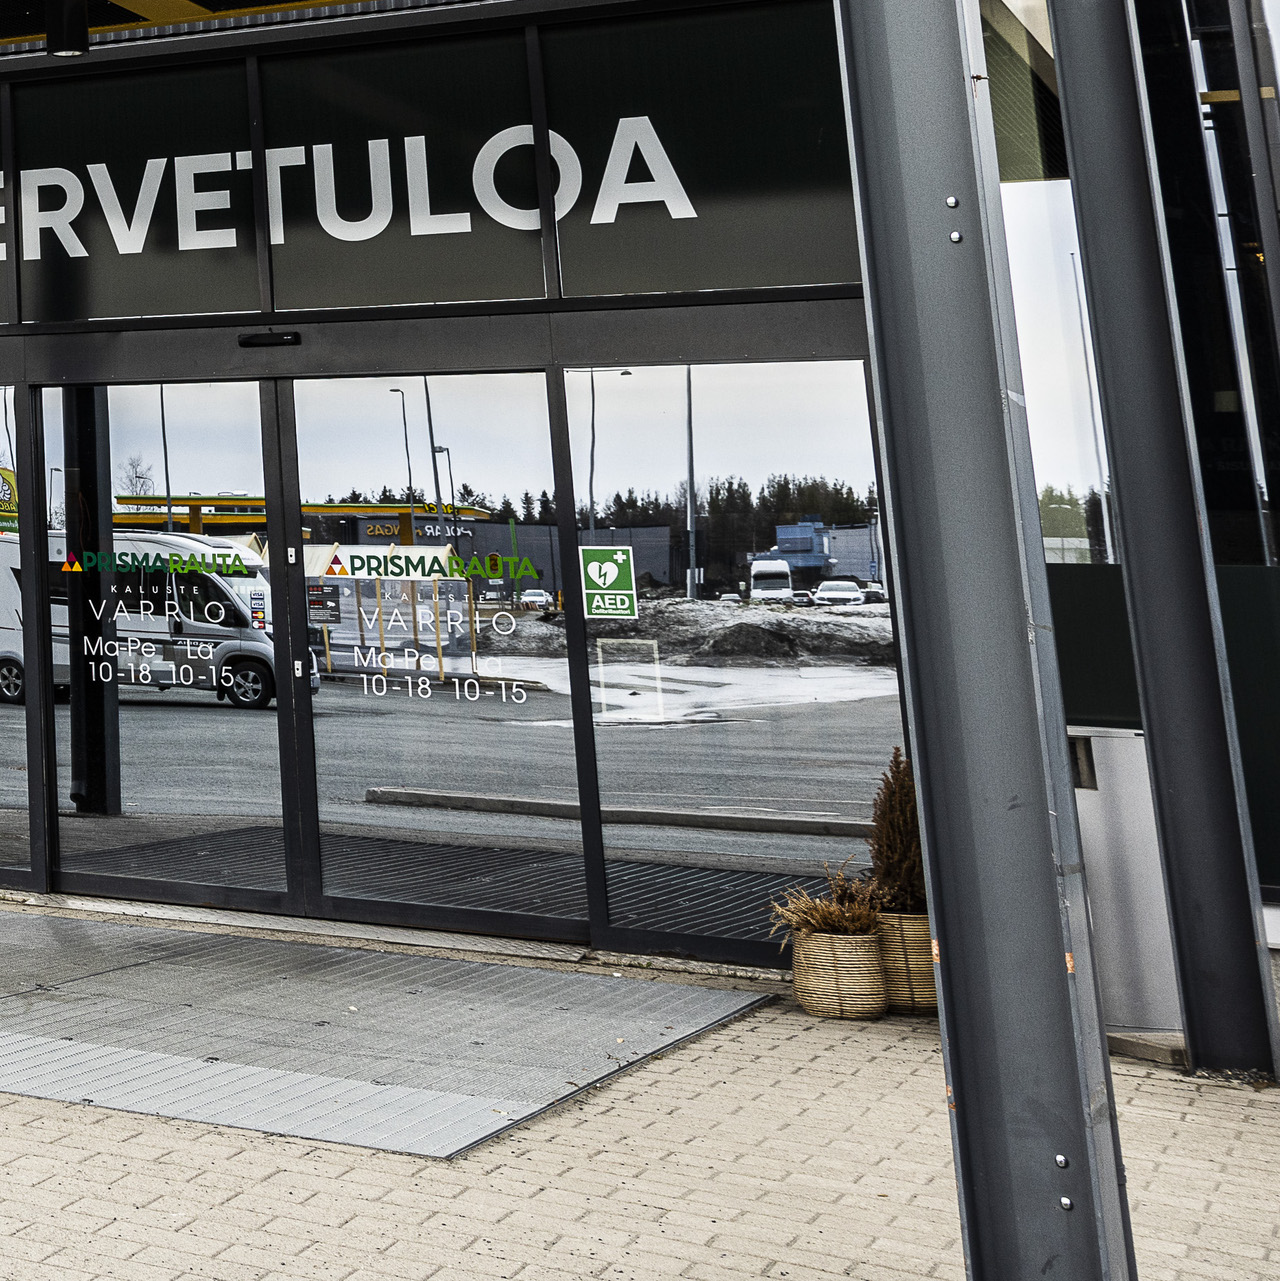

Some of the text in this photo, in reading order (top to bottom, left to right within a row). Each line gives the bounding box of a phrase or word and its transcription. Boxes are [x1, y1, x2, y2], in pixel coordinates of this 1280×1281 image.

[82, 551, 248, 574] PRISMARAUTA
[349, 554, 539, 580] PRISMARAUTA
[110, 585, 199, 595] KALUSTE
[384, 593, 487, 604] KALUSTE
[592, 595, 630, 609] AED
[89, 599, 225, 623] VARRIO
[359, 607, 516, 635] VARRIO
[84, 636, 213, 660] Ma-Pe La
[354, 646, 502, 674] Ma-Pe La
